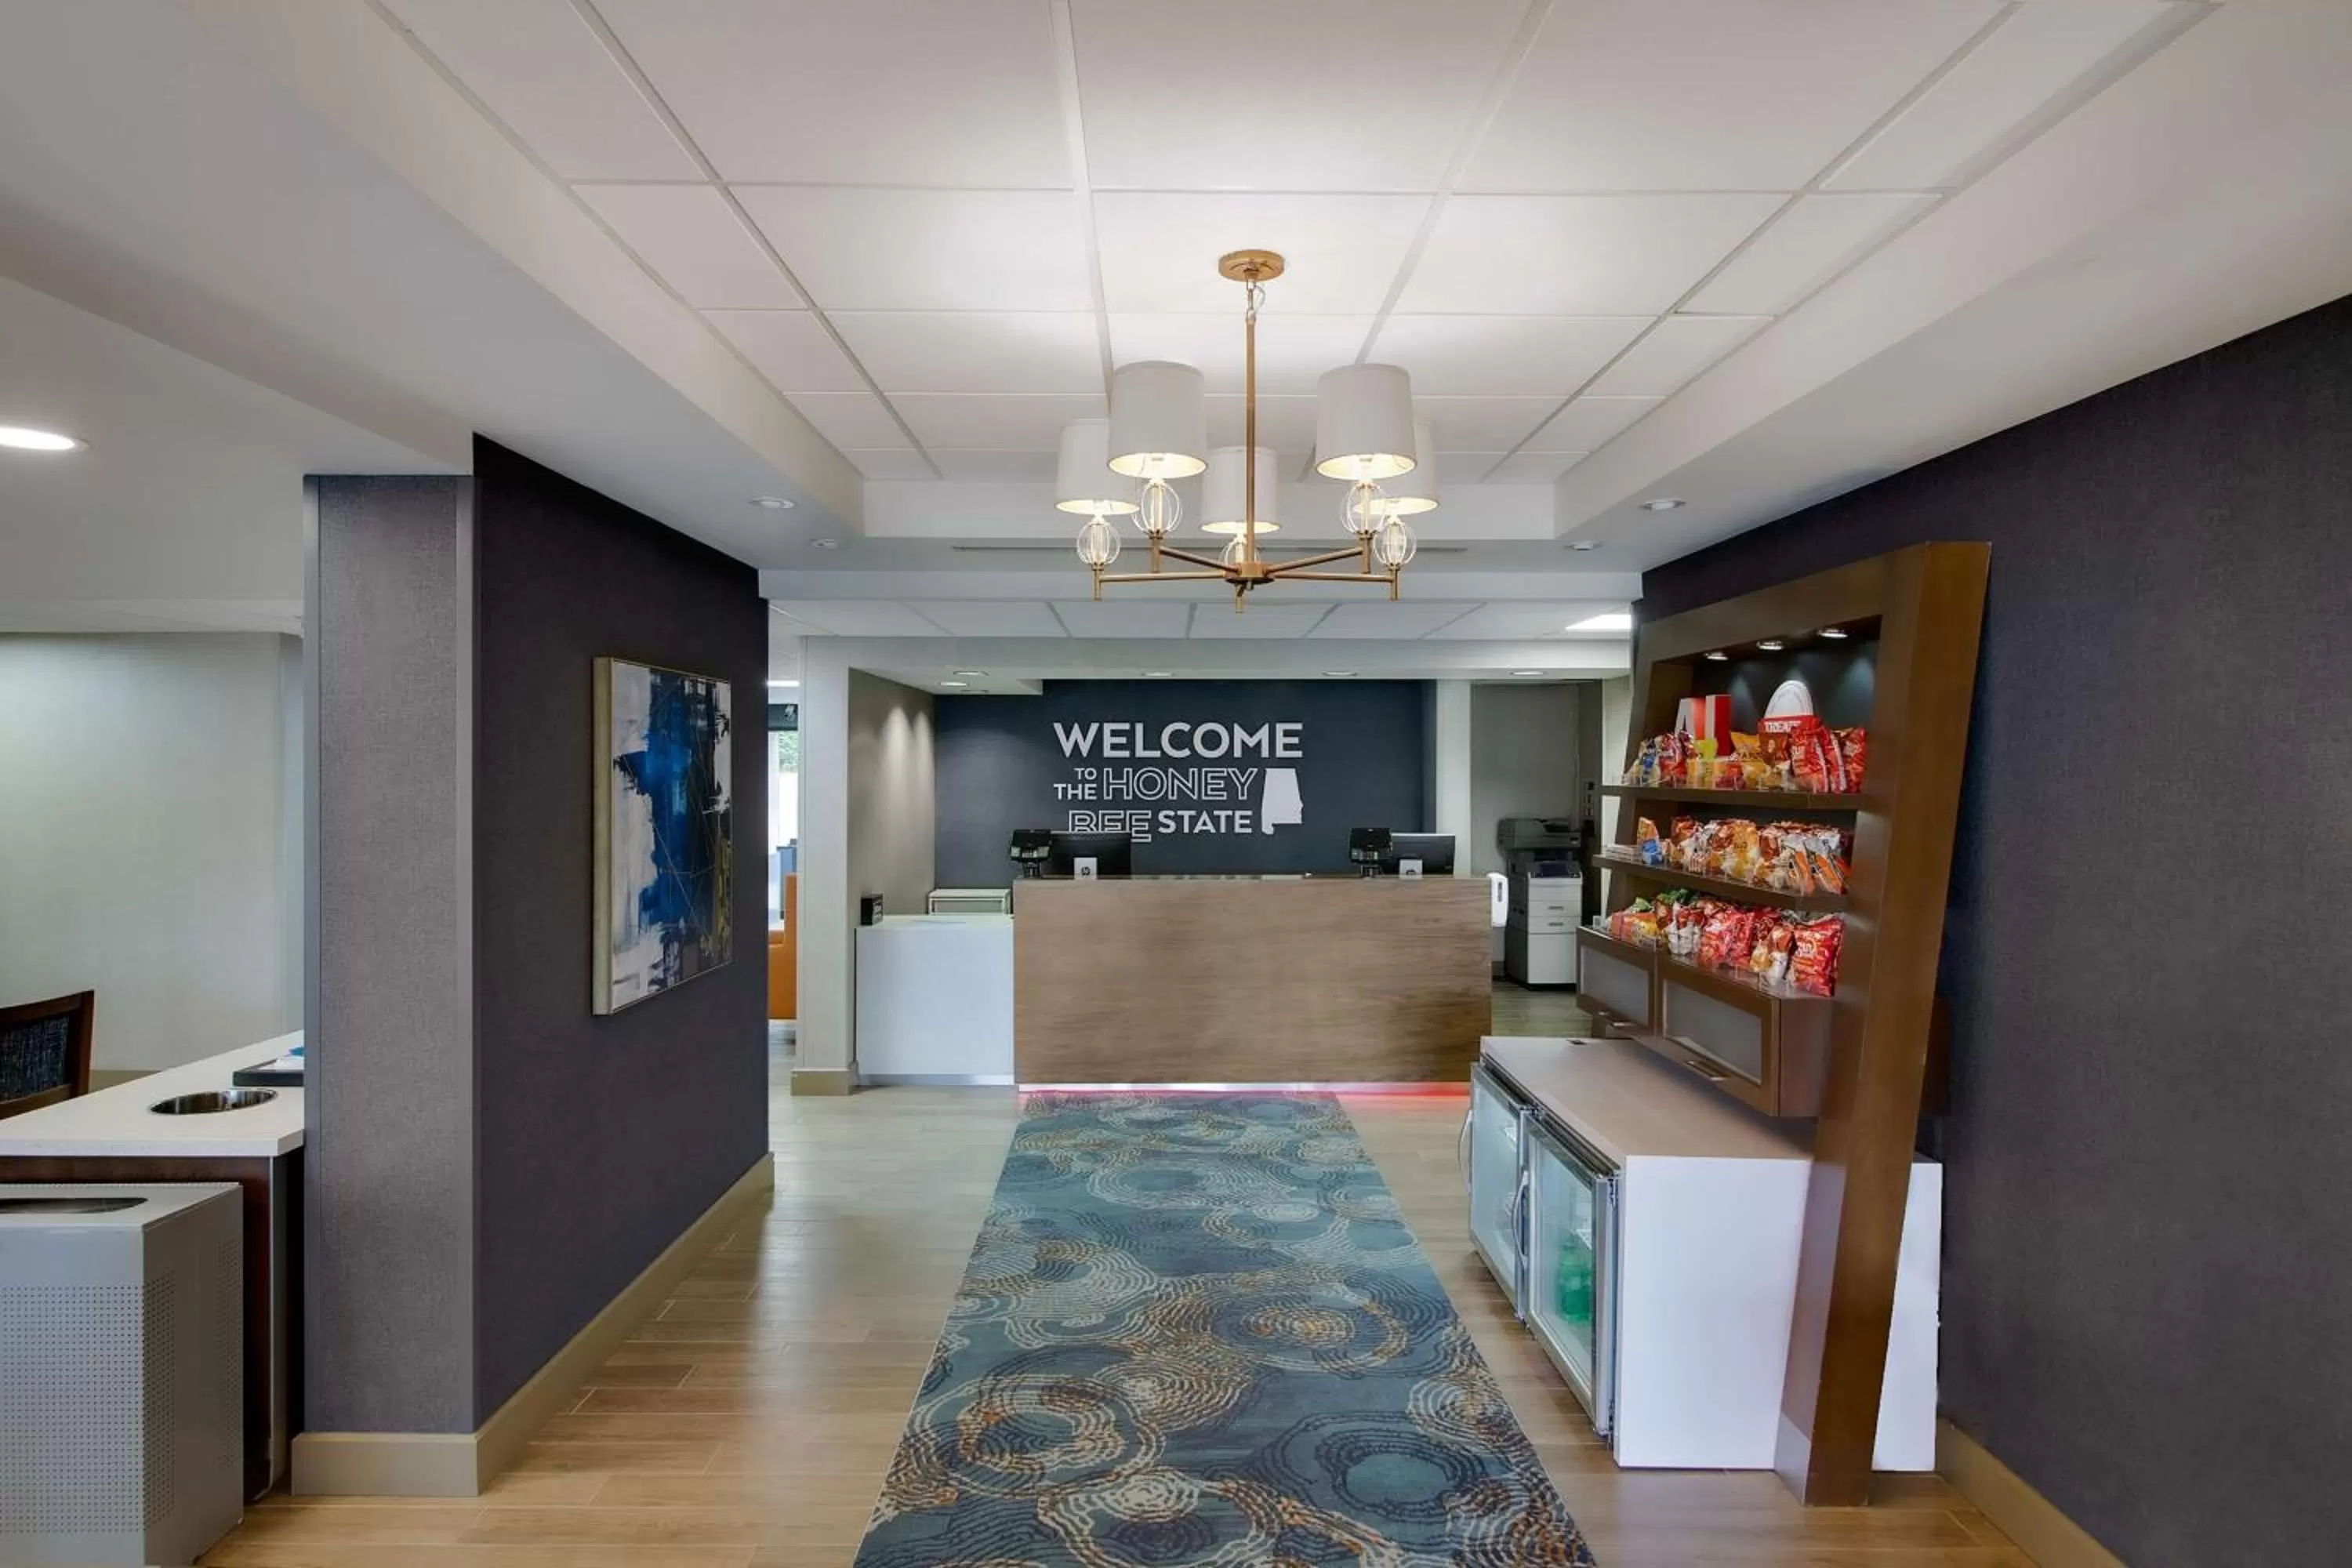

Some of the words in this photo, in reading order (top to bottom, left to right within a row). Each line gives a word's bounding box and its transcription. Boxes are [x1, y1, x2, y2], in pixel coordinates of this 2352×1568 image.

[1764, 720, 1802, 733] TREA
[1053, 721, 1303, 758] WELCOME
[1053, 783, 1098, 800] THE
[1103, 767, 1258, 800] HONEY
[1074, 768, 1097, 780] TO
[1158, 809, 1253, 833] STATE
